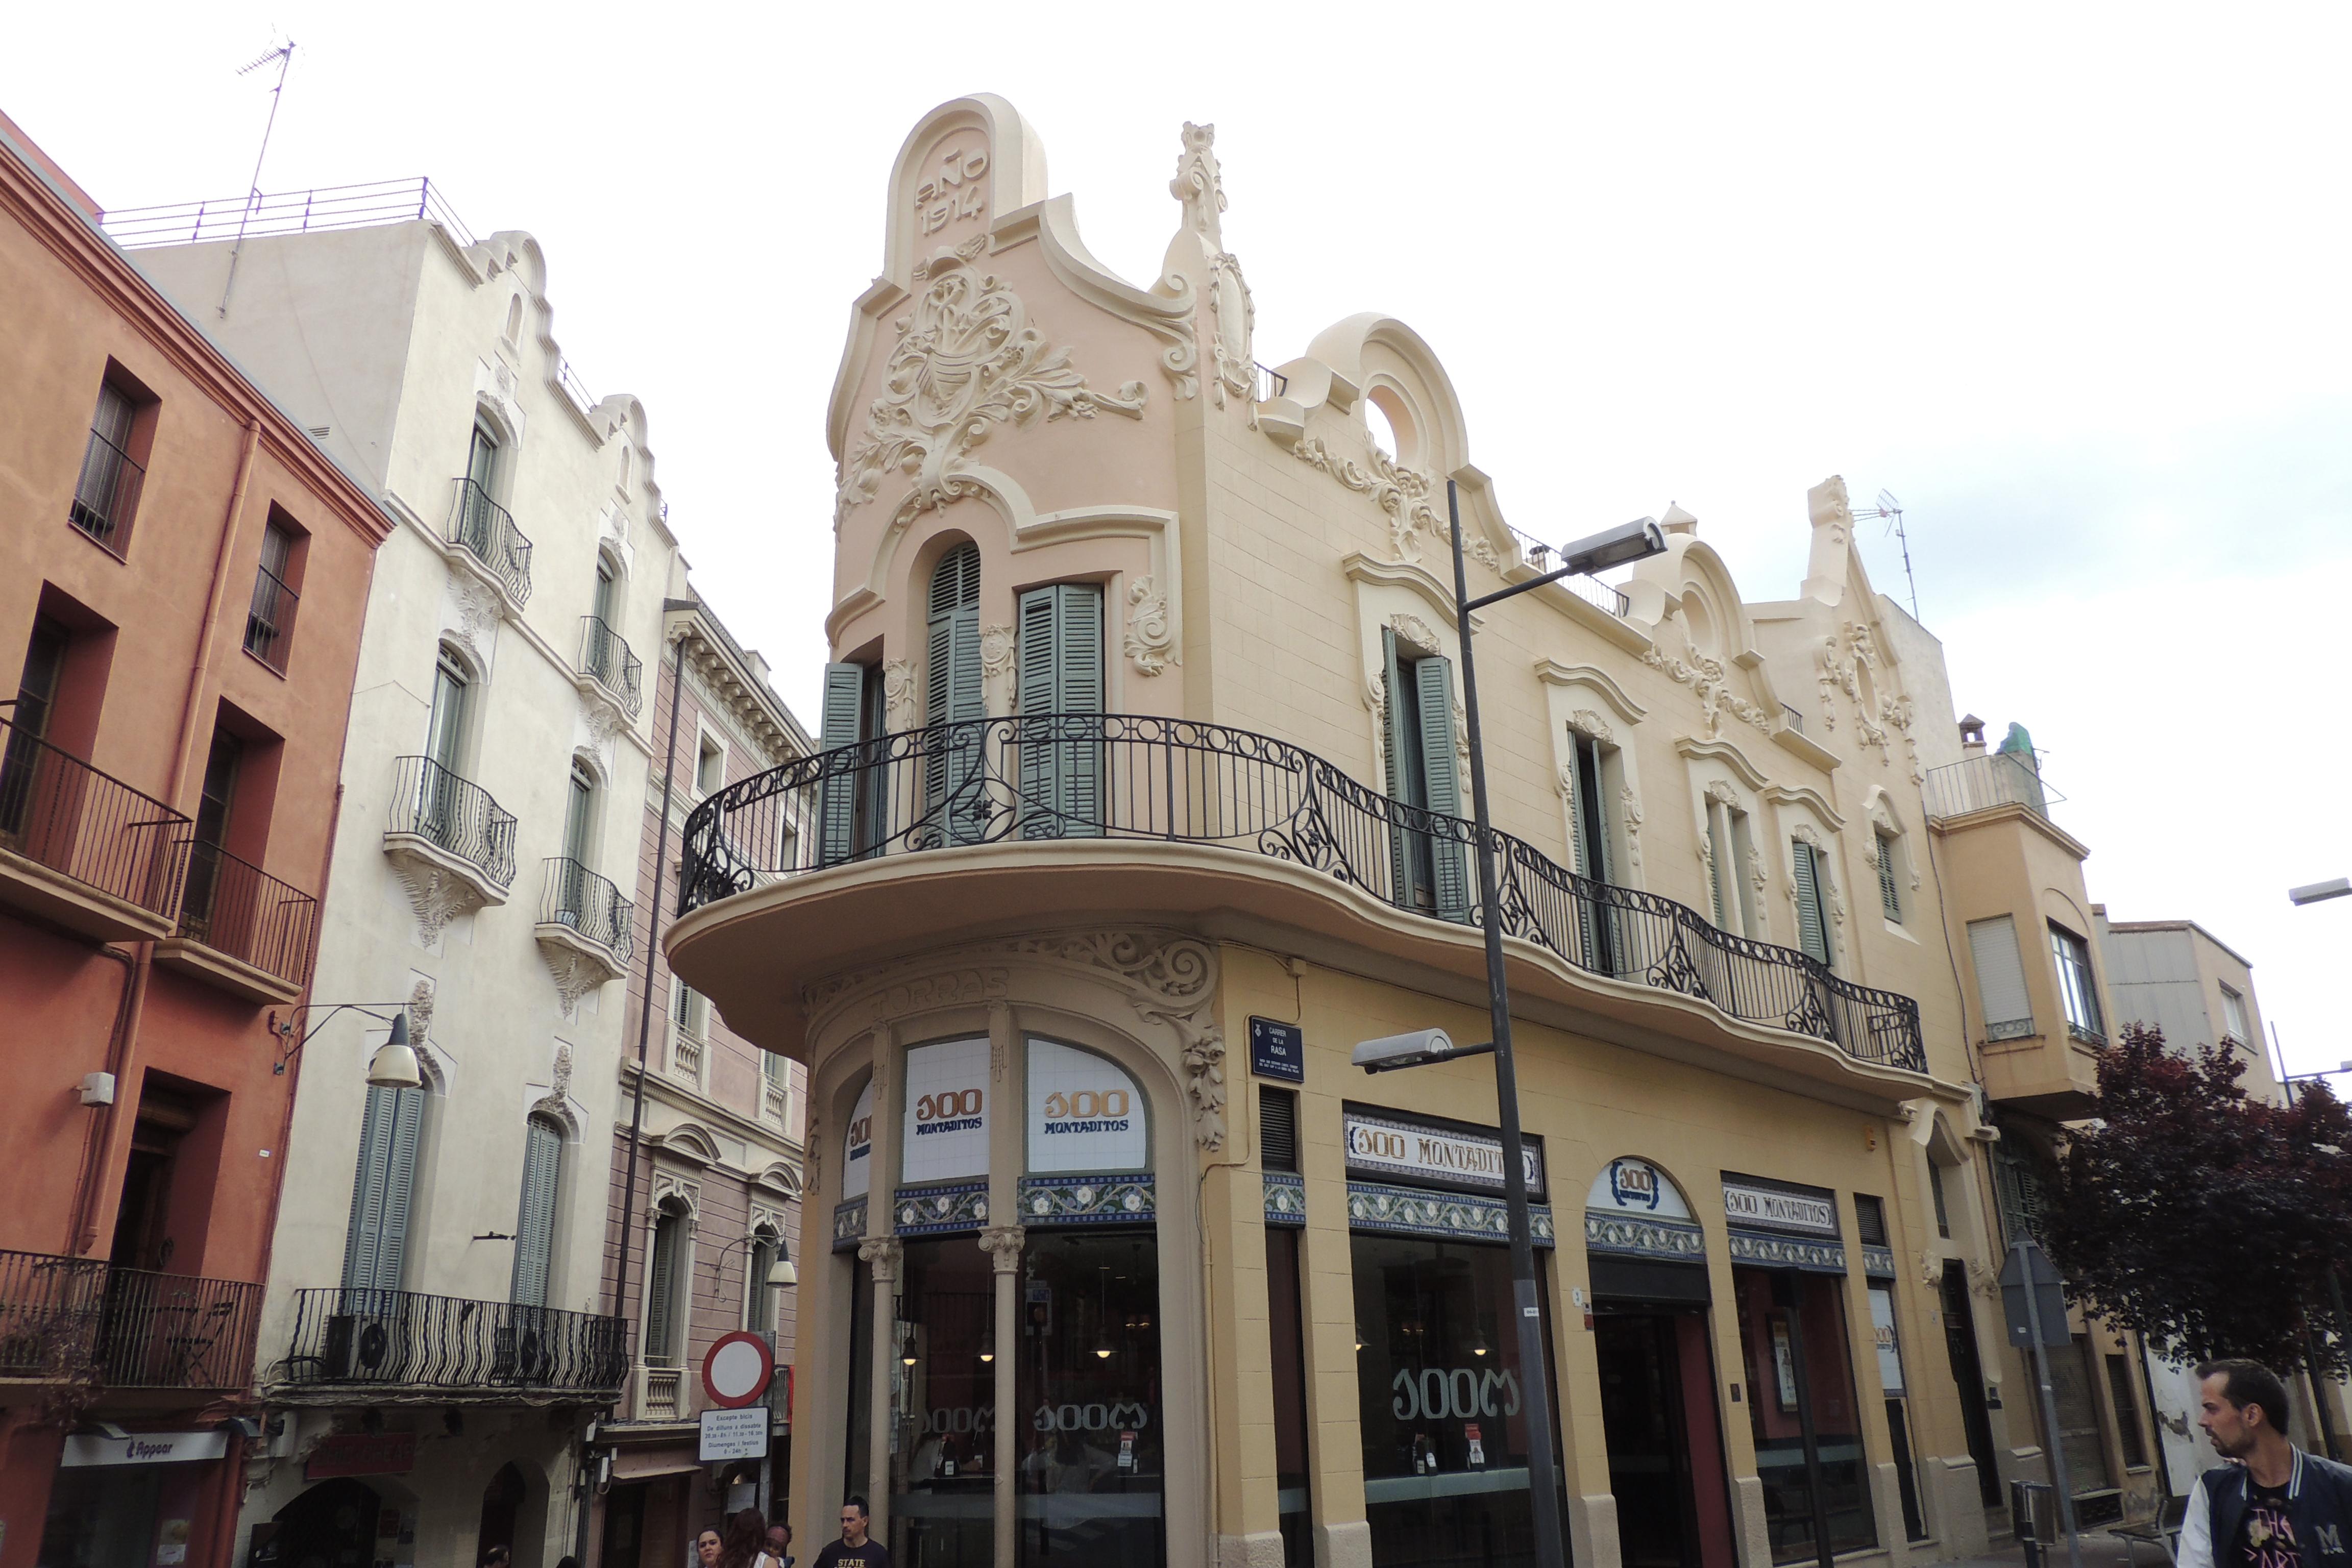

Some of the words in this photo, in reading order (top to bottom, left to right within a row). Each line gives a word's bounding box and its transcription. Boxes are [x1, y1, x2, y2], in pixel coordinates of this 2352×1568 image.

[915, 148, 990, 209] AÑO
[921, 186, 984, 236] 1914
[870, 967, 1010, 1018] TORRAS
[1268, 1026, 1287, 1037] CARRER
[1270, 1045, 1286, 1056] RASA
[916, 1117, 983, 1135] MONTADITOS
[1044, 1119, 1129, 1134] MONTADITOS
[1763, 1196, 1827, 1223] MONTADITOS
[136, 1441, 173, 1459] Appear
[2315, 1525, 2342, 1548] M
[838, 1558, 866, 1566] STATE
